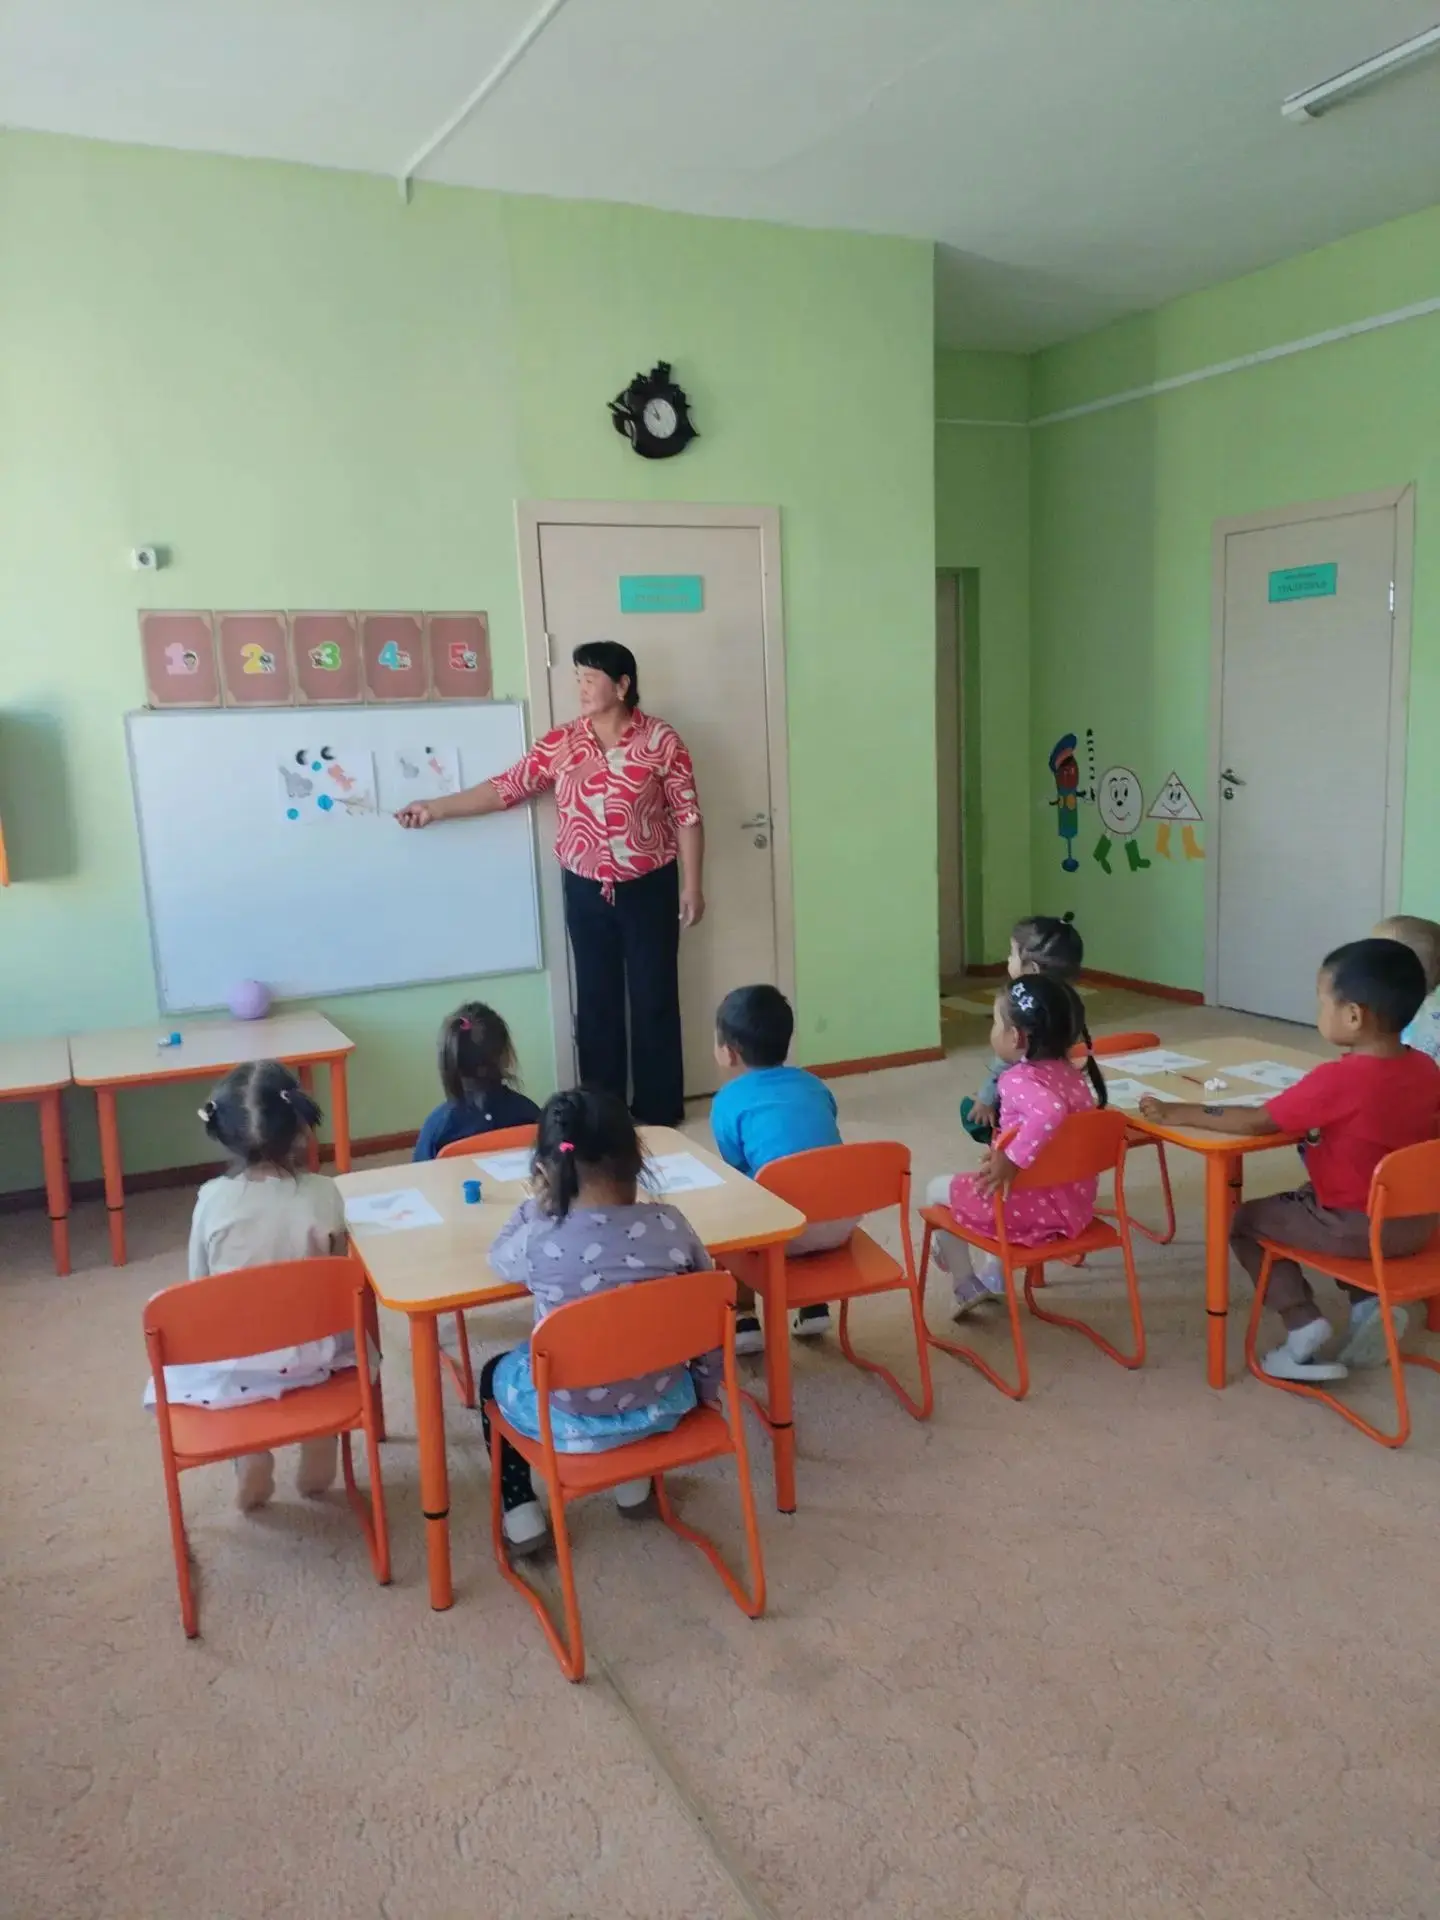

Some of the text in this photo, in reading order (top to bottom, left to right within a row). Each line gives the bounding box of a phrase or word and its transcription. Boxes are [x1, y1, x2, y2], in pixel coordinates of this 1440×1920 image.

[165, 642, 197, 675] 1
[241, 643, 270, 674] 2
[316, 641, 341, 670] 3
[379, 641, 400, 670] 4
[450, 642, 470, 670] 5
